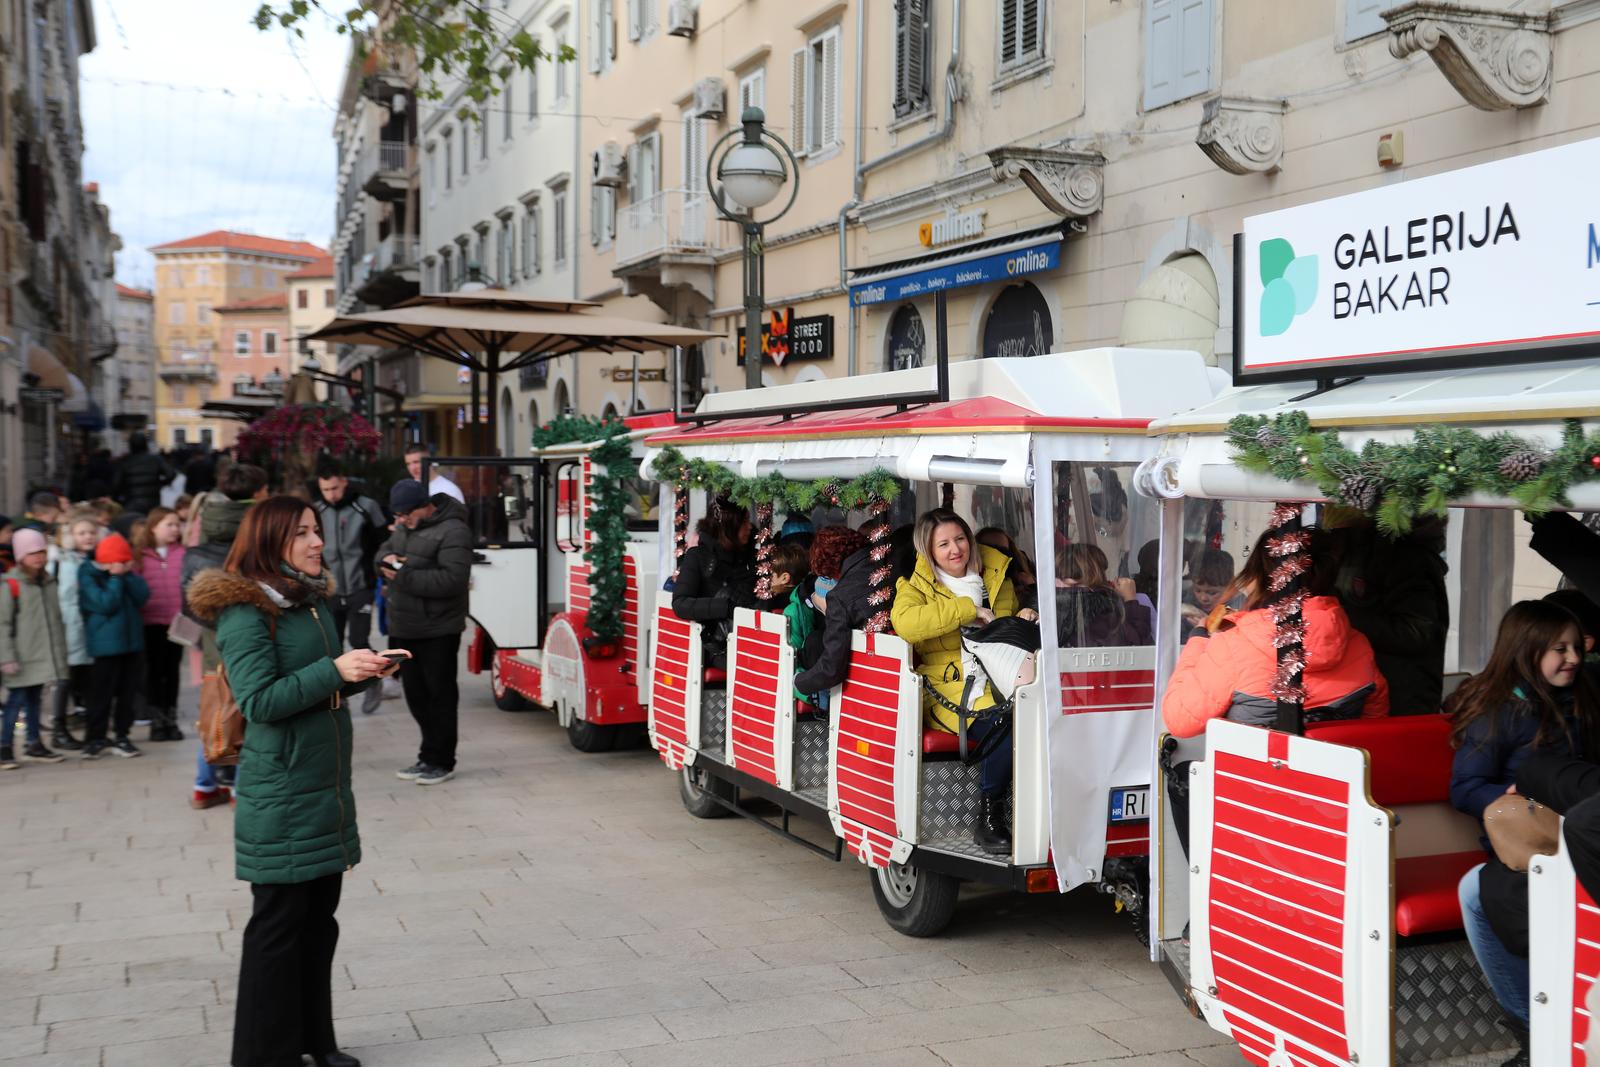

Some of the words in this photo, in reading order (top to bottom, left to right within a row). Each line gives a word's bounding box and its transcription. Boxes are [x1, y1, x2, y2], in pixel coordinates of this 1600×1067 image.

[932, 205, 987, 245] mlinar
[1333, 201, 1520, 271] GALERIJA
[860, 285, 886, 304] mlinar
[1333, 266, 1451, 320] BAKAR
[793, 322, 823, 339] STREET
[739, 333, 770, 357] FX
[793, 339, 823, 354] FOOD
[1112, 808, 1122, 816] HR
[1125, 793, 1145, 816] RI
